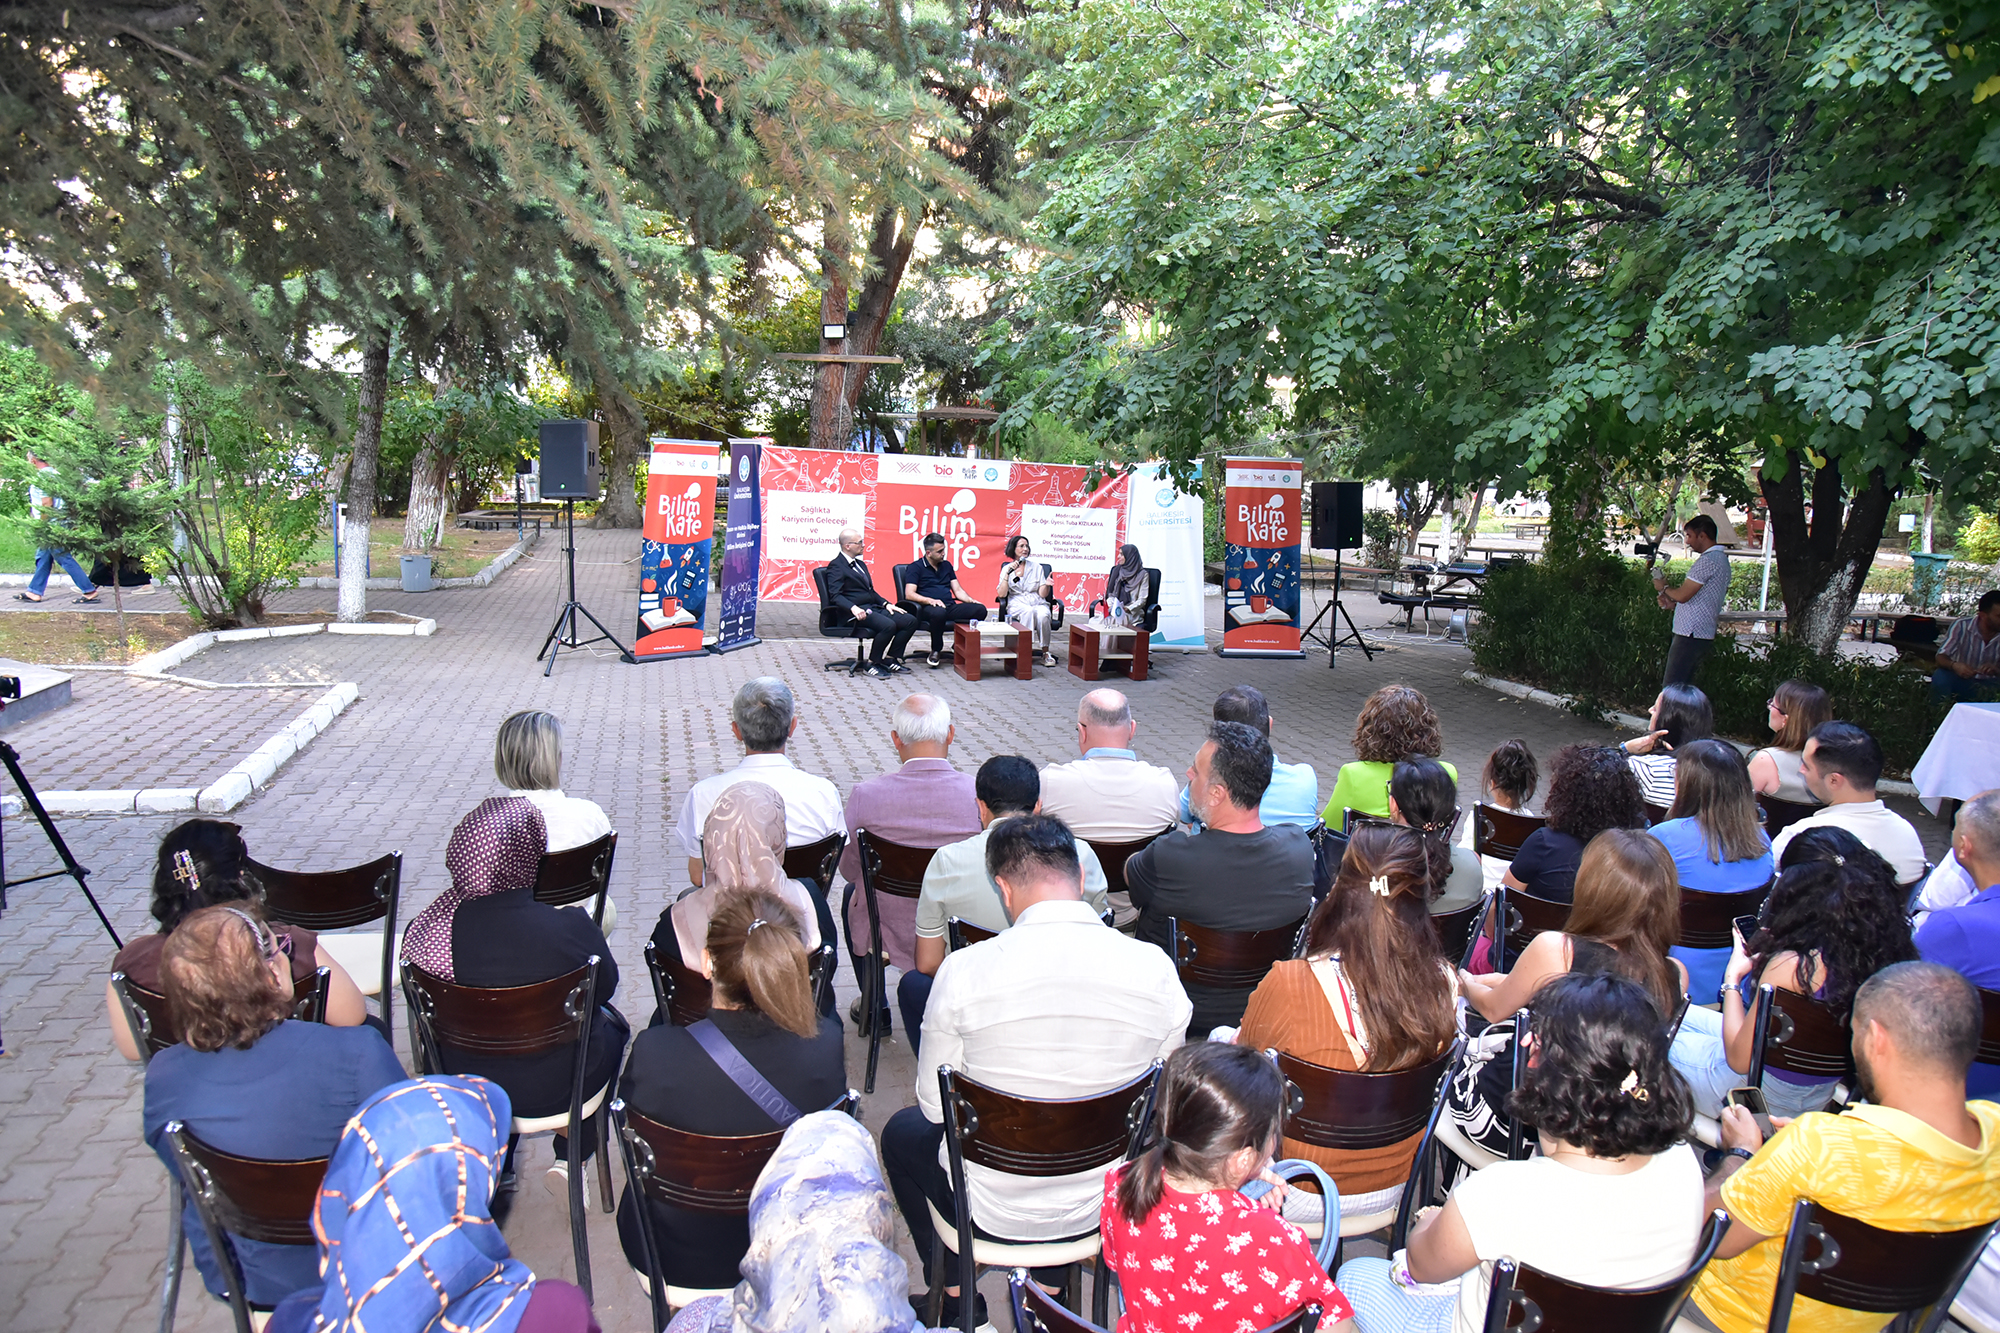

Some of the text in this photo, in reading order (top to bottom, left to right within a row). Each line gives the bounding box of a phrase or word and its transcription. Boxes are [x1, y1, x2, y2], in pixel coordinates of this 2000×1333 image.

[658, 494, 700, 516] Bilim
[800, 506, 831, 514] Sağlıkta
[1238, 504, 1285, 524] Bilim
[666, 511, 702, 538] Kafe
[781, 515, 848, 526] Kariyerin Geleceği
[899, 505, 976, 539] Bilim
[1139, 516, 1192, 526] ÜNİVERSİTESİ
[1247, 519, 1288, 543] Kafe
[912, 531, 980, 572] Kfe
[726, 1054, 801, 1123] AUTICA
